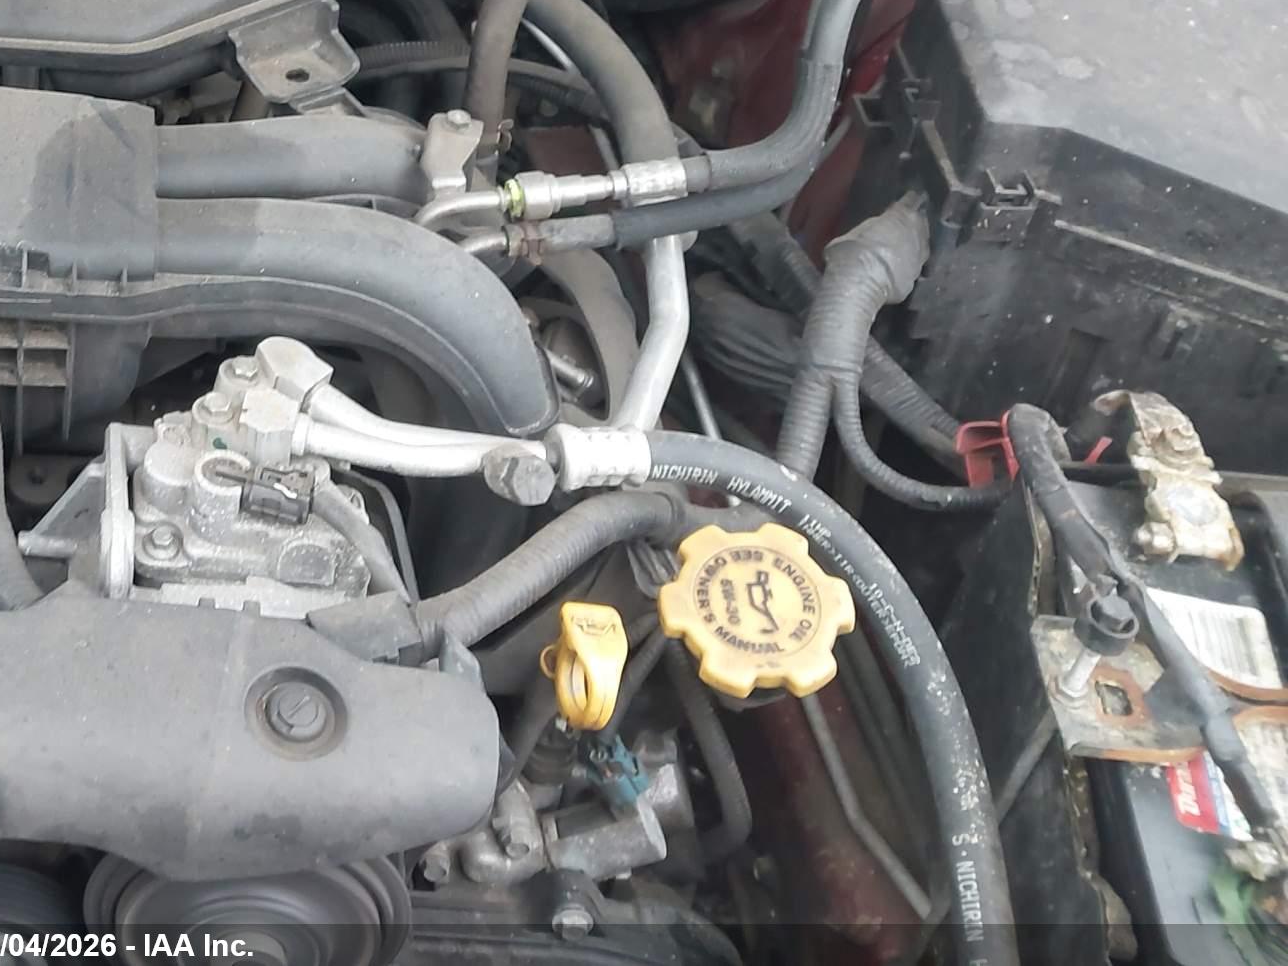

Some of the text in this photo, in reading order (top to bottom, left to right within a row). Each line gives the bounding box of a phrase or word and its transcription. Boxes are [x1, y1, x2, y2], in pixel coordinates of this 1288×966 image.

[651, 463, 719, 485] NICHIRIN
[771, 554, 817, 642] ENGINE OIL
[713, 625, 786, 654] MANUAL
